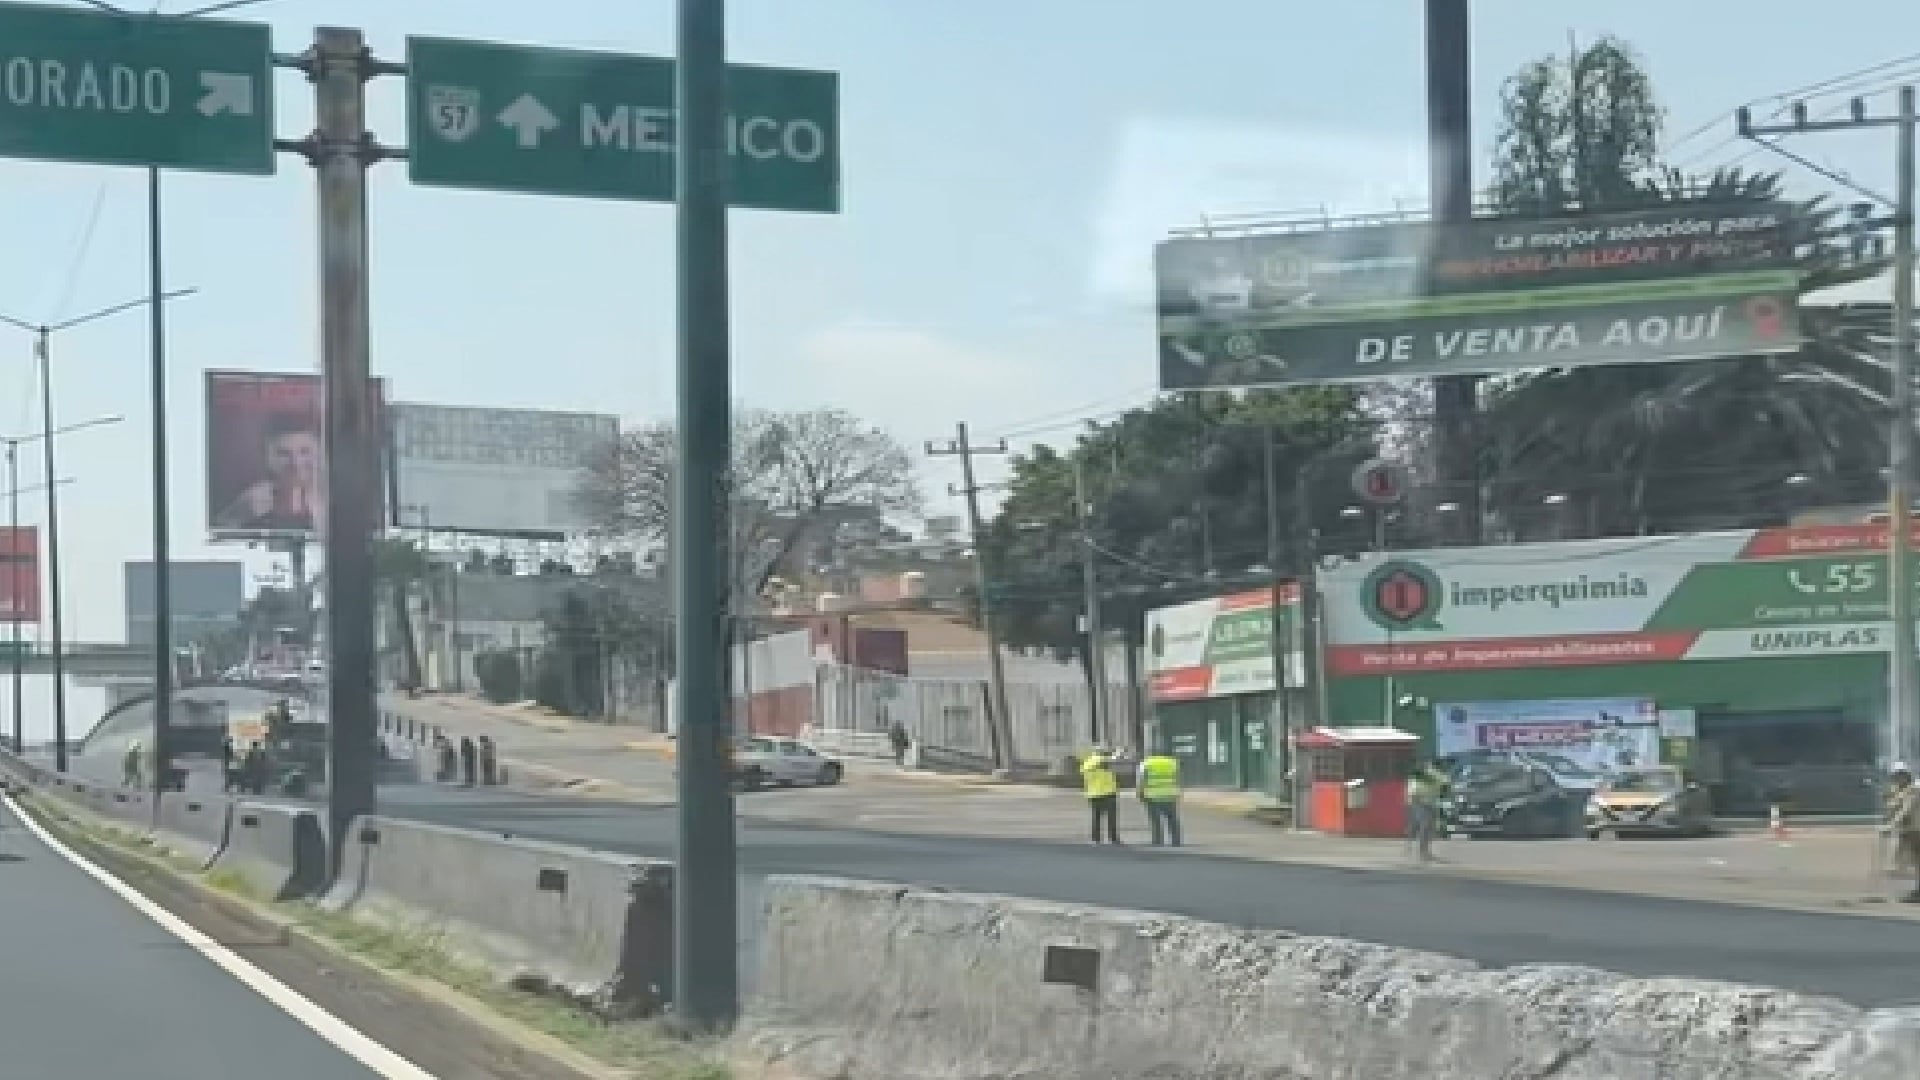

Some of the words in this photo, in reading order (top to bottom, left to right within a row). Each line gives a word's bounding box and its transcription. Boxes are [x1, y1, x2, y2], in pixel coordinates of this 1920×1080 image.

[5, 56, 170, 114] ORADO
[440, 105, 467, 130] 57
[580, 102, 824, 163] MEICO
[1494, 234, 1524, 248] La
[1531, 226, 1601, 248] mejor
[1607, 217, 1712, 241] solución
[1716, 213, 1776, 235] para
[1356, 335, 1414, 363] DE
[1434, 321, 1580, 359] VENTA
[1601, 304, 1727, 347] AQUÍ
[1451, 572, 1648, 611] imperquimia
[1823, 562, 1877, 593] 55
[1750, 628, 1880, 651] UNIPLAS
